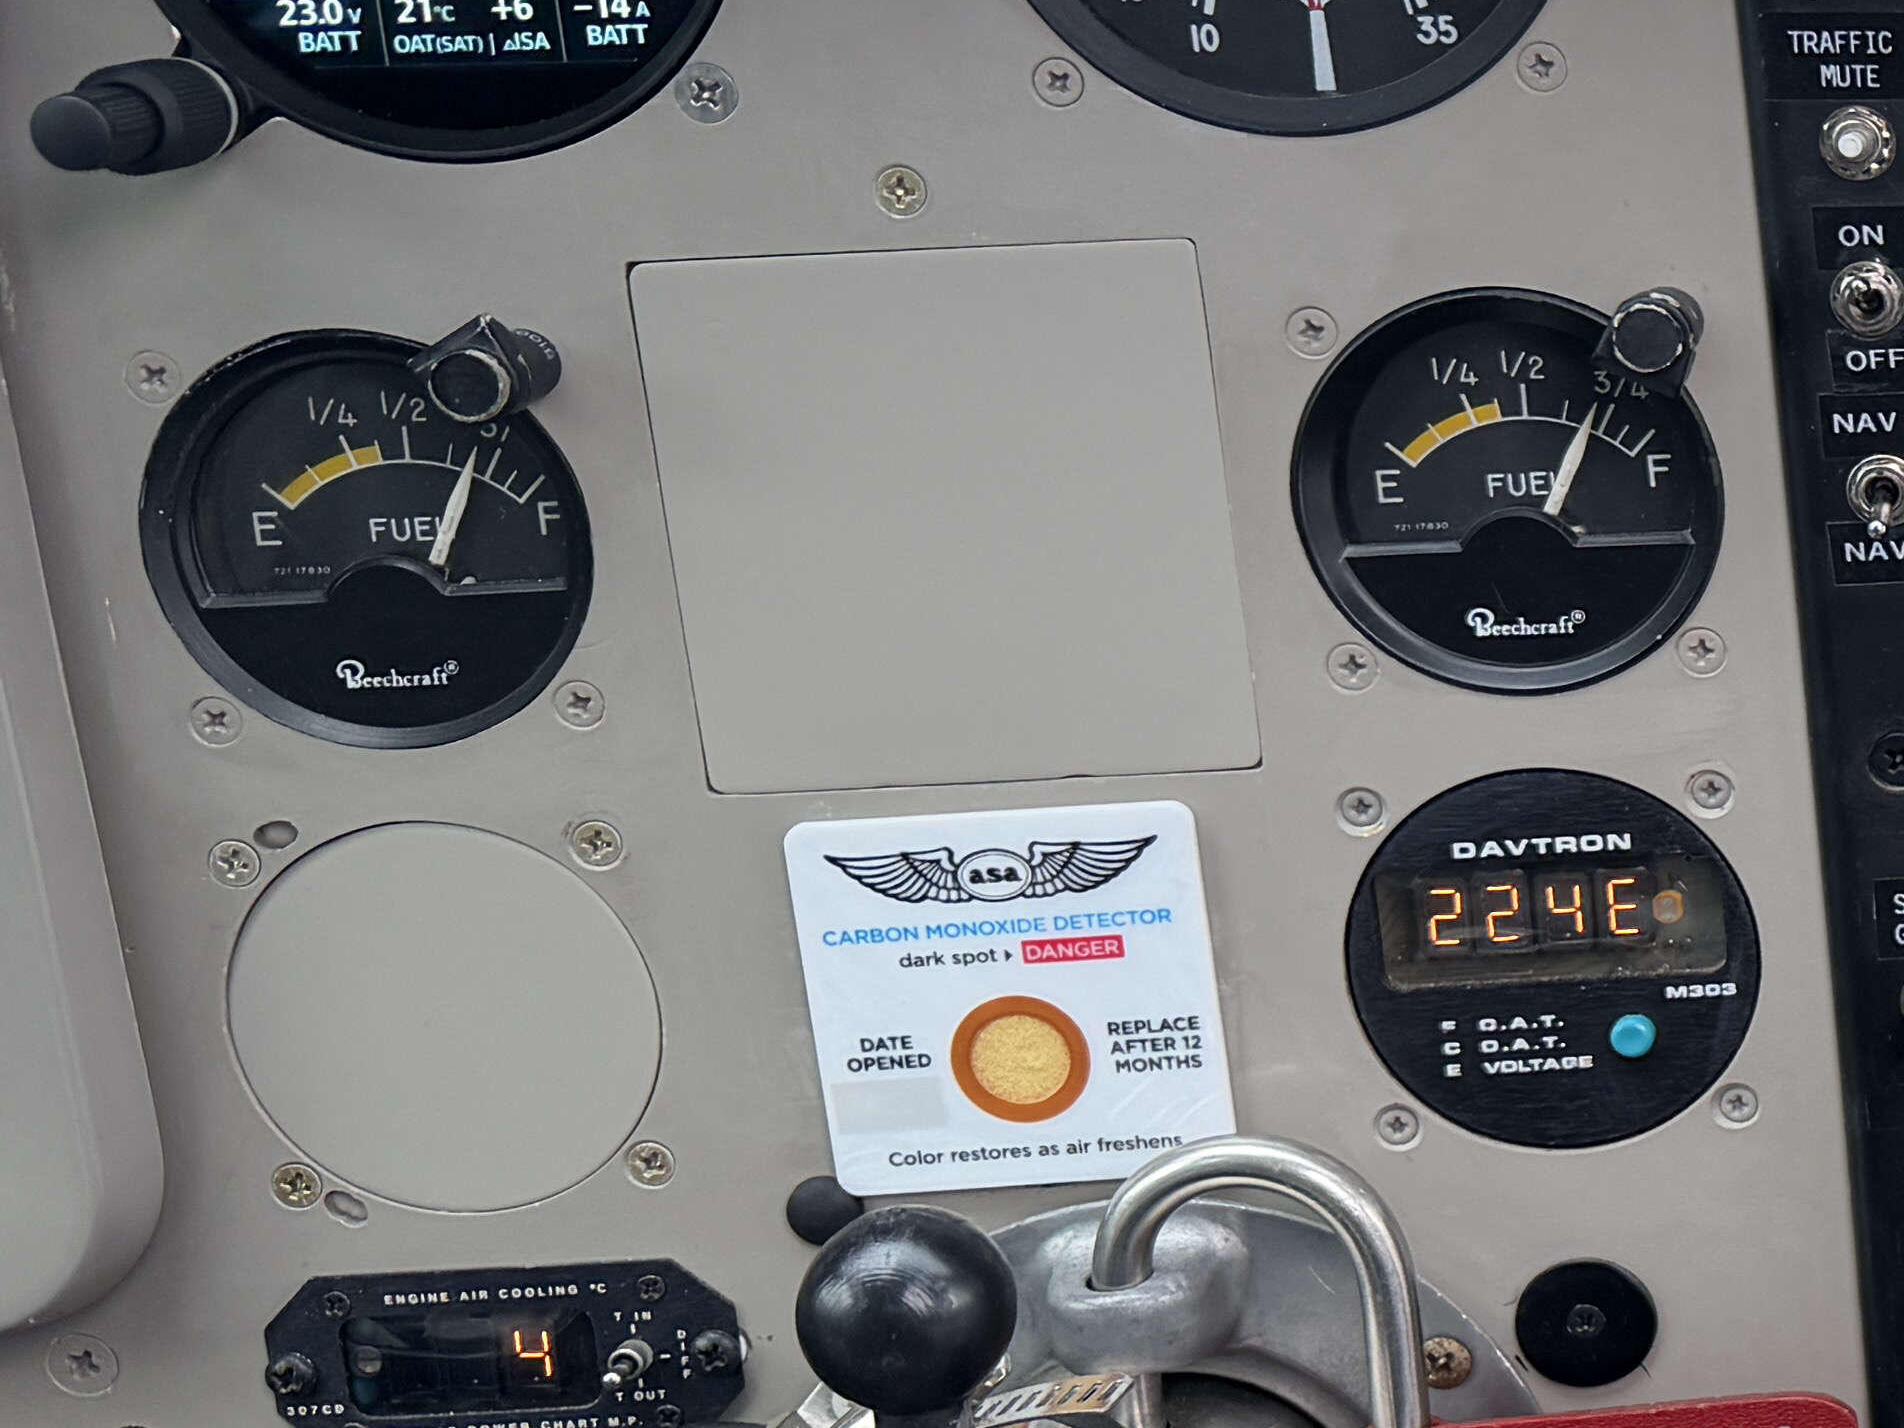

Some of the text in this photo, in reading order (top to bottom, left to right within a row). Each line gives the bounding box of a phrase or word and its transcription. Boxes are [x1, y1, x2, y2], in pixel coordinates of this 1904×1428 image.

[1788, 30, 1893, 54] TRAFFIC
[1820, 64, 1880, 89] MUTE
[1594, 371, 1649, 398] 3/4
[308, 396, 357, 427] 1/4
[253, 512, 282, 546] E
[1452, 833, 1631, 860] DAVTRON
[969, 866, 1022, 885] asa
[1428, 878, 1639, 946] 224E
[822, 908, 1172, 947] CARBON MONOXIDE DETECTOR
[899, 940, 1120, 968] dark spot DANGER
[1665, 983, 1737, 999] M303
[1107, 1016, 1201, 1036] REPLACE
[860, 1036, 913, 1052] DATE
[1110, 1035, 1203, 1055] AFTER 12
[846, 1054, 932, 1073] OPENED
[1115, 1055, 1202, 1073] MONTHS
[1482, 1055, 1594, 1074] VOLTAGE
[889, 1132, 1183, 1167] Color restores as air freshens
[384, 1292, 450, 1306] ENGINE
[460, 1290, 488, 1301] AIR
[498, 1284, 578, 1299] COOLING
[287, 1404, 345, 1416] 307CD
